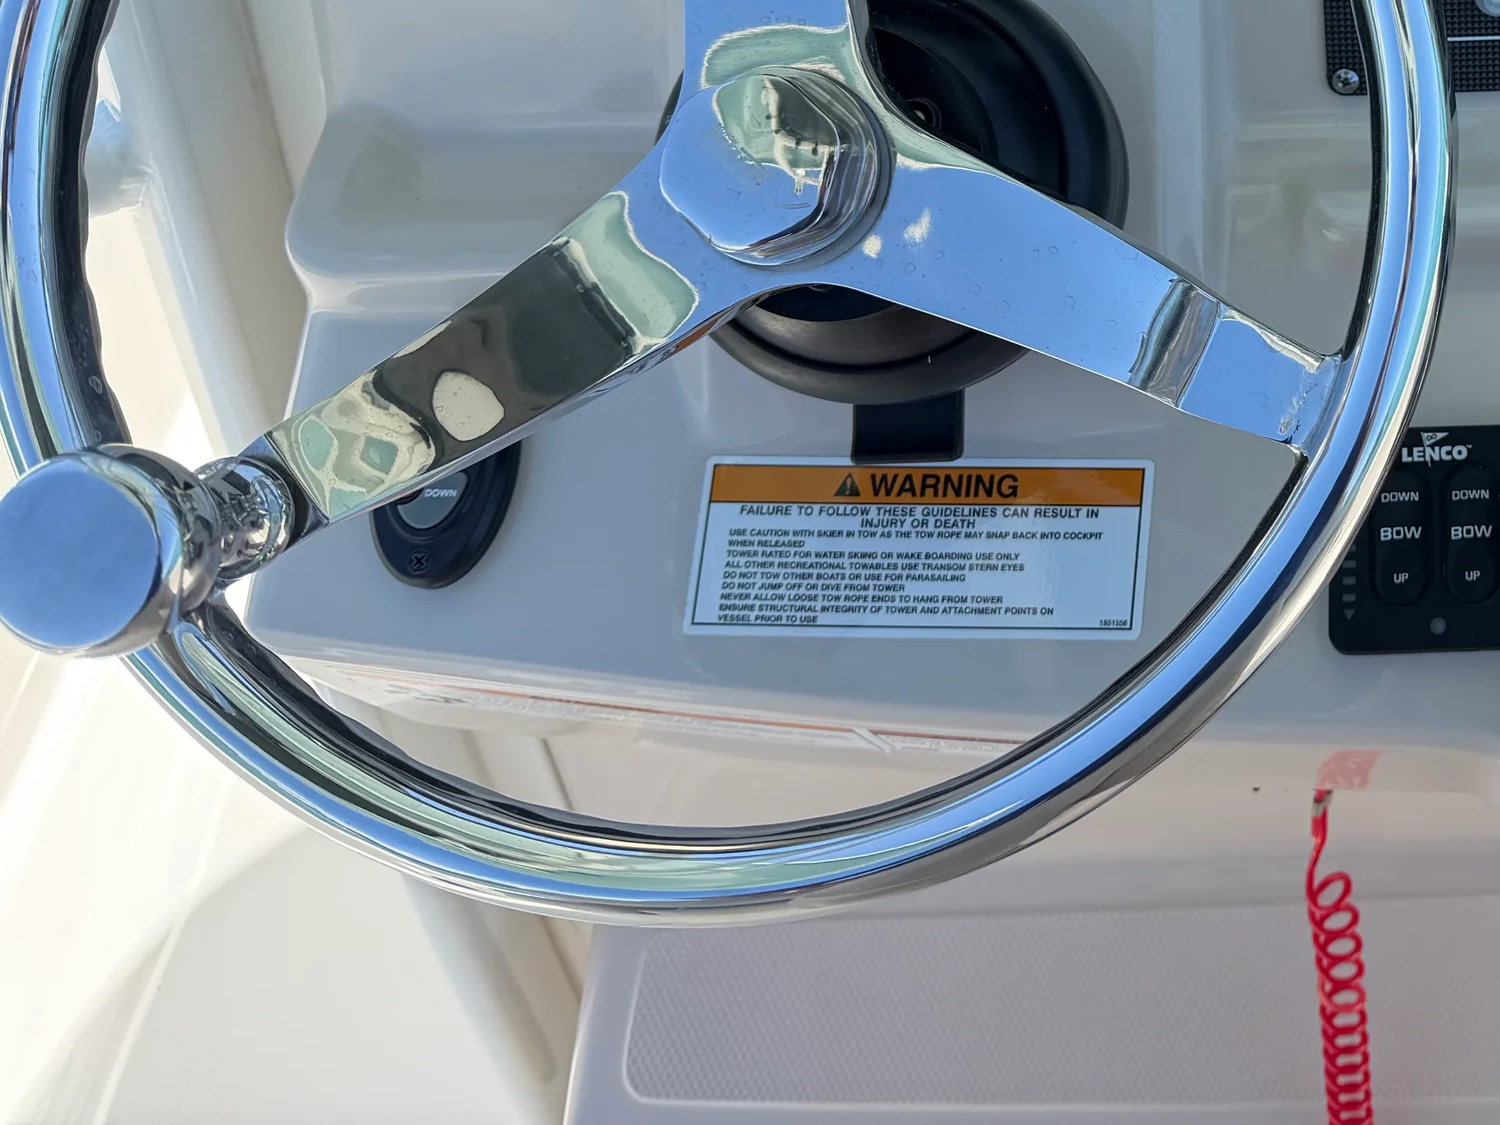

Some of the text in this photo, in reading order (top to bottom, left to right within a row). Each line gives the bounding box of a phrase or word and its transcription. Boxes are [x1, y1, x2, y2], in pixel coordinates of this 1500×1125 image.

[1401, 444, 1468, 464] LENCO
[870, 473, 1019, 499] WARNING
[423, 488, 458, 498] DOWN
[1381, 491, 1420, 503] DOWN
[1451, 489, 1490, 501] DOWN
[740, 504, 1100, 519] FAILURE TO FOLLOW THESE GUIDELINES CAN RESULT IN
[860, 518, 976, 529] INJURY OR DEATH
[729, 528, 1104, 540] USE CAUTION WITH SKIER IN TOW AS THE TOW ROPE MAY SNAP BACK INTO COCKPIT
[1380, 525, 1423, 542] BOW
[1450, 524, 1493, 541] BOW
[727, 539, 805, 548] WHEN RELEASED
[726, 549, 1021, 561] TOWER RATED FOR WATER SKIING OR WAKE BOARDING USE ONLY
[724, 560, 847, 570] ALL OTHER RECREATIONAL
[1393, 572, 1410, 584] UP
[1465, 570, 1481, 582] UP
